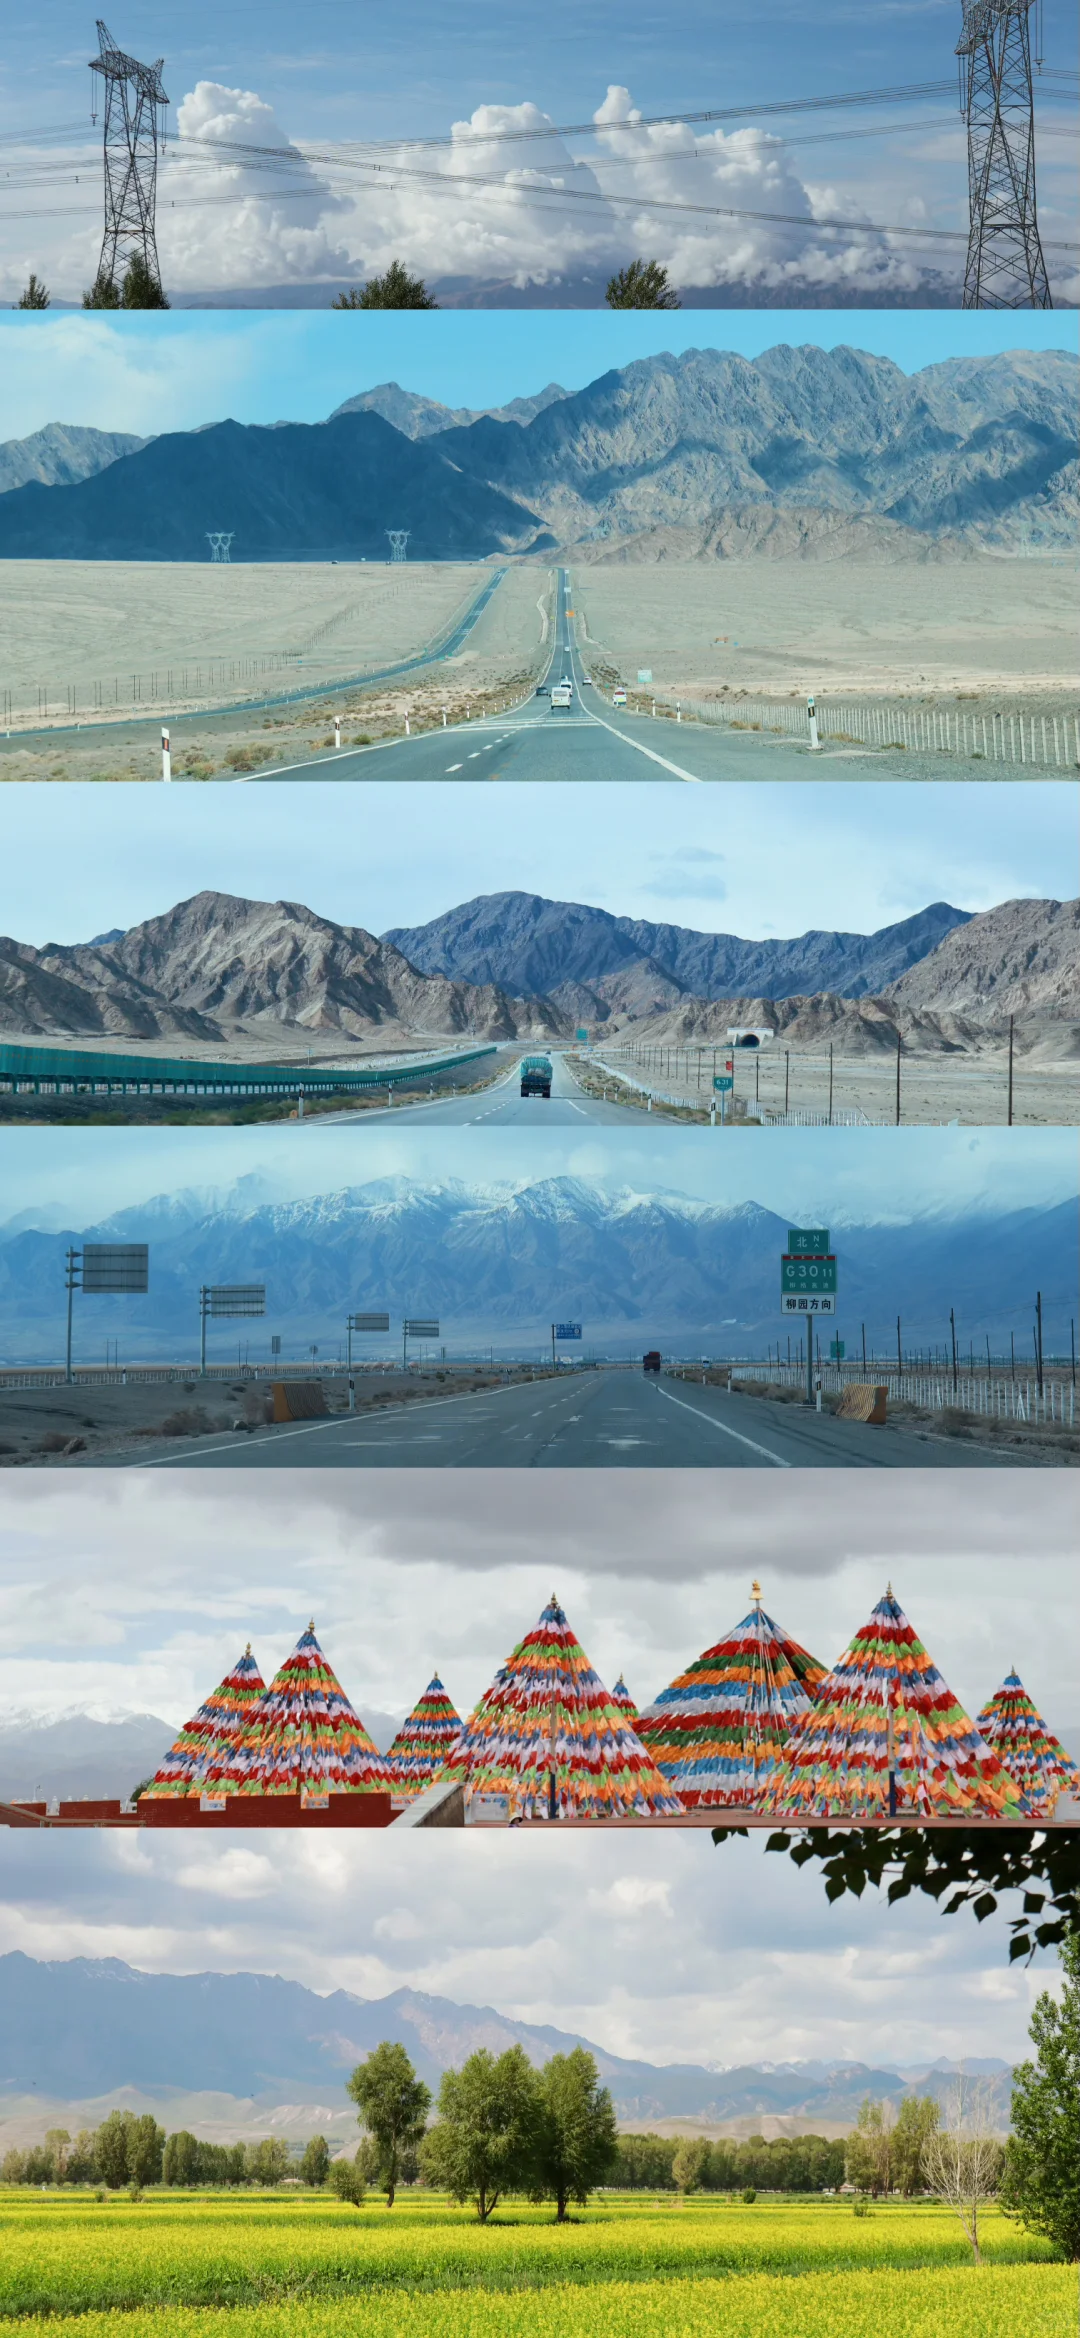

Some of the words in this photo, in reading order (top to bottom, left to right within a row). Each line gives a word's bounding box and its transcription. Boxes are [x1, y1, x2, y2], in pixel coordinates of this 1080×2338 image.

[797, 1236, 808, 1248] 北
[786, 1298, 831, 1310] 柳园方向
